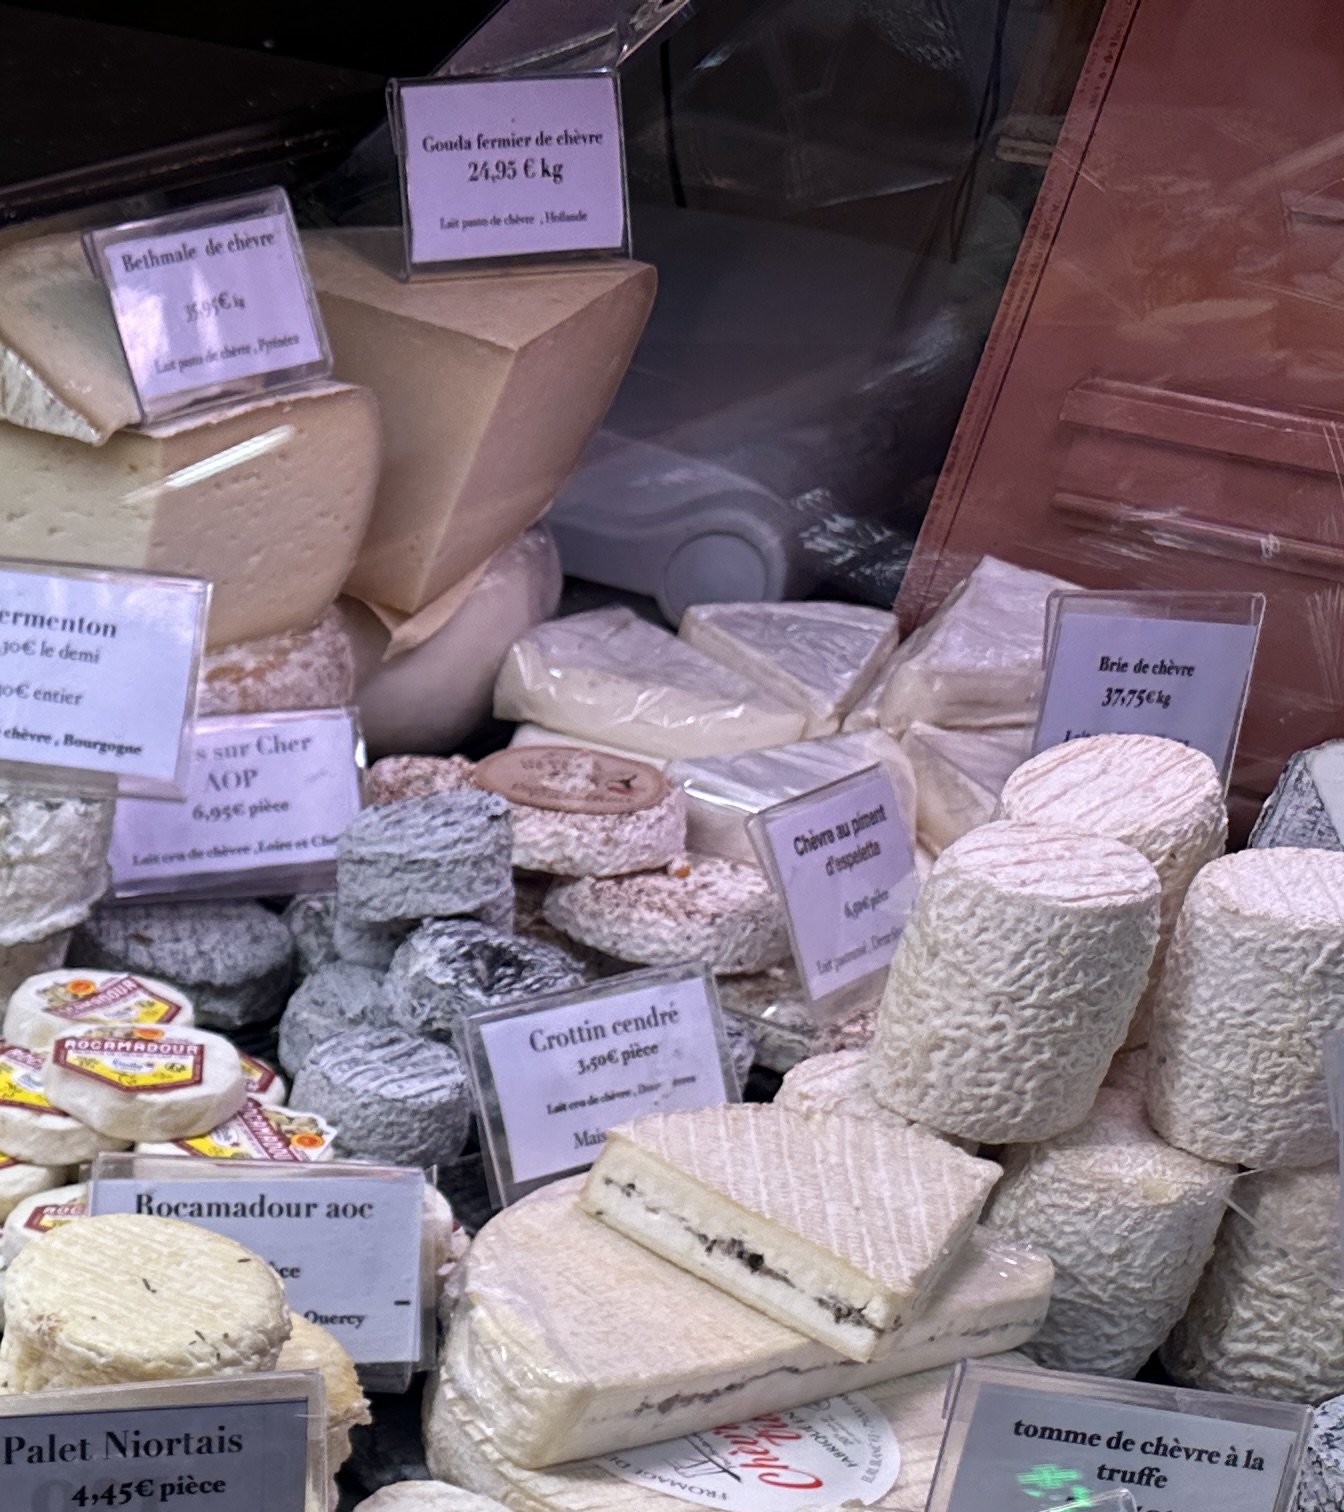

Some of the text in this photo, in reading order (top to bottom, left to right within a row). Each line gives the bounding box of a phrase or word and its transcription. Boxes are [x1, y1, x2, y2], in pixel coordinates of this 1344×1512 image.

[422, 129, 603, 153] Gouda fermier de chèvre
[468, 160, 517, 183] 24,95
[540, 157, 564, 184] kg
[121, 242, 196, 273] Bethmale
[205, 237, 223, 257] de
[40, 639, 56, 658] le
[59, 640, 101, 664] demi
[1098, 655, 1195, 677] Brie de chèvre
[211, 733, 312, 761] sur Cher
[206, 768, 260, 793] AOP
[191, 799, 245, 822] 6,95€
[793, 804, 888, 857] Chèvre au piment
[528, 1001, 679, 1053] Crottin cendré
[577, 1041, 660, 1076] 3,50€ pièce
[135, 1193, 374, 1220] Rocamadour aoc
[305, 1309, 367, 1330] Quercy
[3, 1425, 243, 1465] Palet Niortais
[1013, 1418, 1265, 1471] tomme de chèvre à la
[1096, 1461, 1169, 1490] truffe
[70, 1474, 227, 1508] 4,45€ pièce
